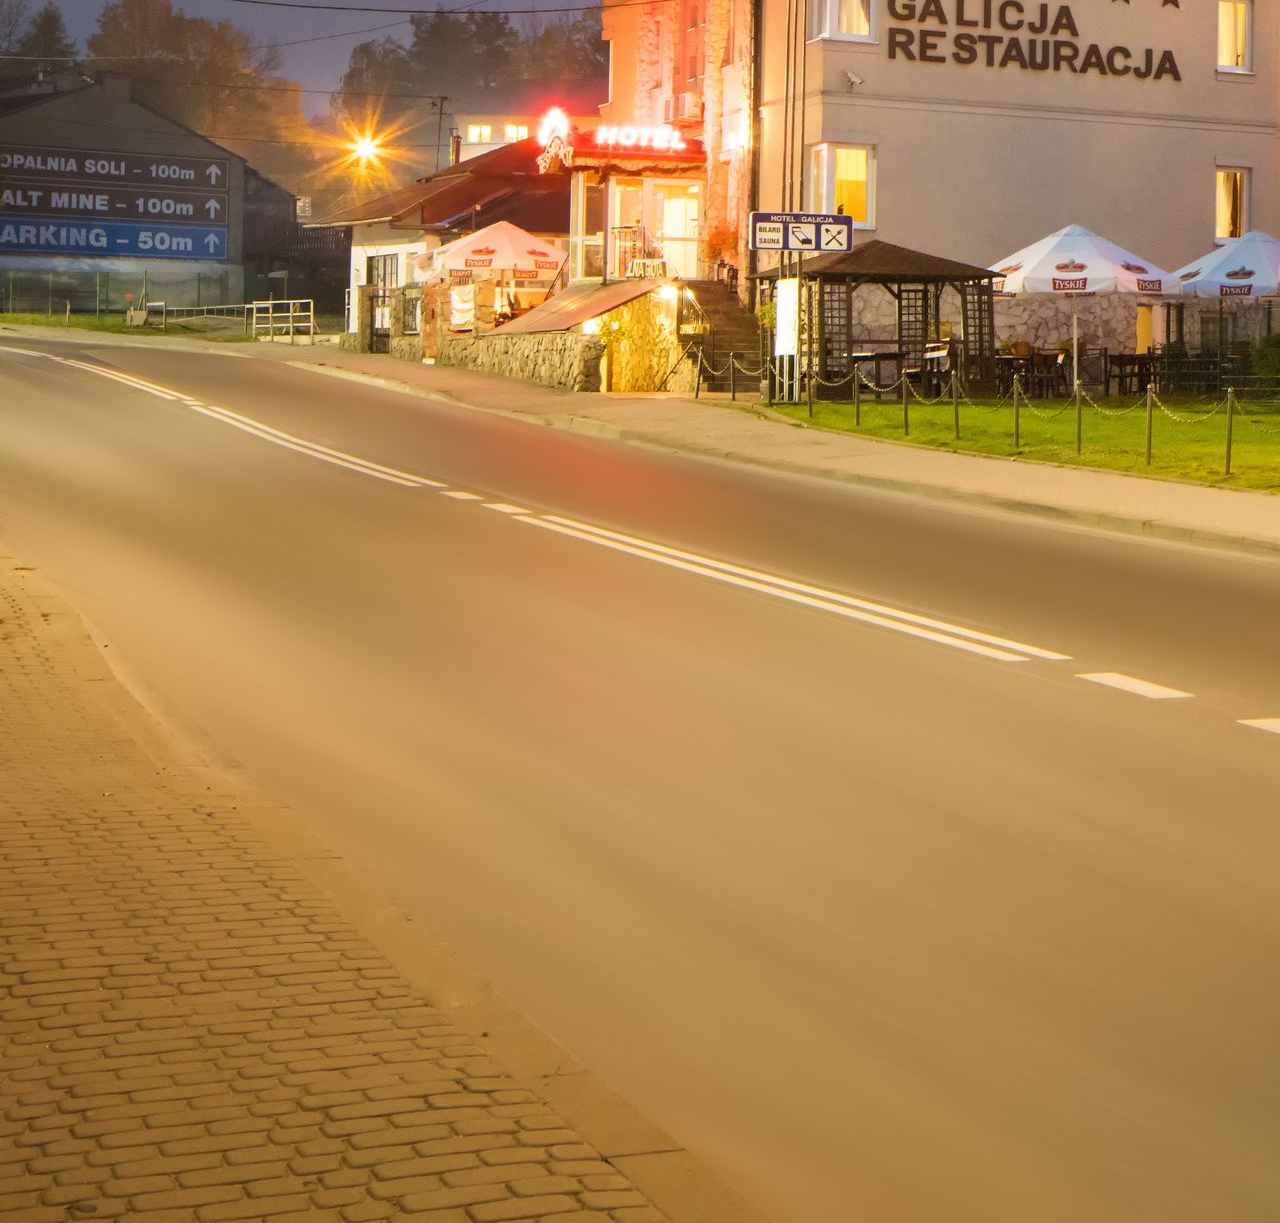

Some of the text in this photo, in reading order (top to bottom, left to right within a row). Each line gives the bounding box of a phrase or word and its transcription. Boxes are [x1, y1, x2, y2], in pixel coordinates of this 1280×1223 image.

[888, 27, 1182, 81] RESTAURACJA
[597, 126, 687, 149] HOTEL
[84, 158, 126, 176] SOLI
[150, 164, 195, 180] 100m
[51, 192, 109, 211] MINE
[136, 198, 193, 215] 100m
[801, 216, 834, 224] GALICJA
[758, 225, 781, 234] BILARD
[137, 231, 193, 252] 50m
[758, 237, 781, 245] SAUNA
[1054, 279, 1086, 290] TYSKIE
[1138, 280, 1160, 290] TYSKIE
[1221, 286, 1250, 295] TYSKIE
